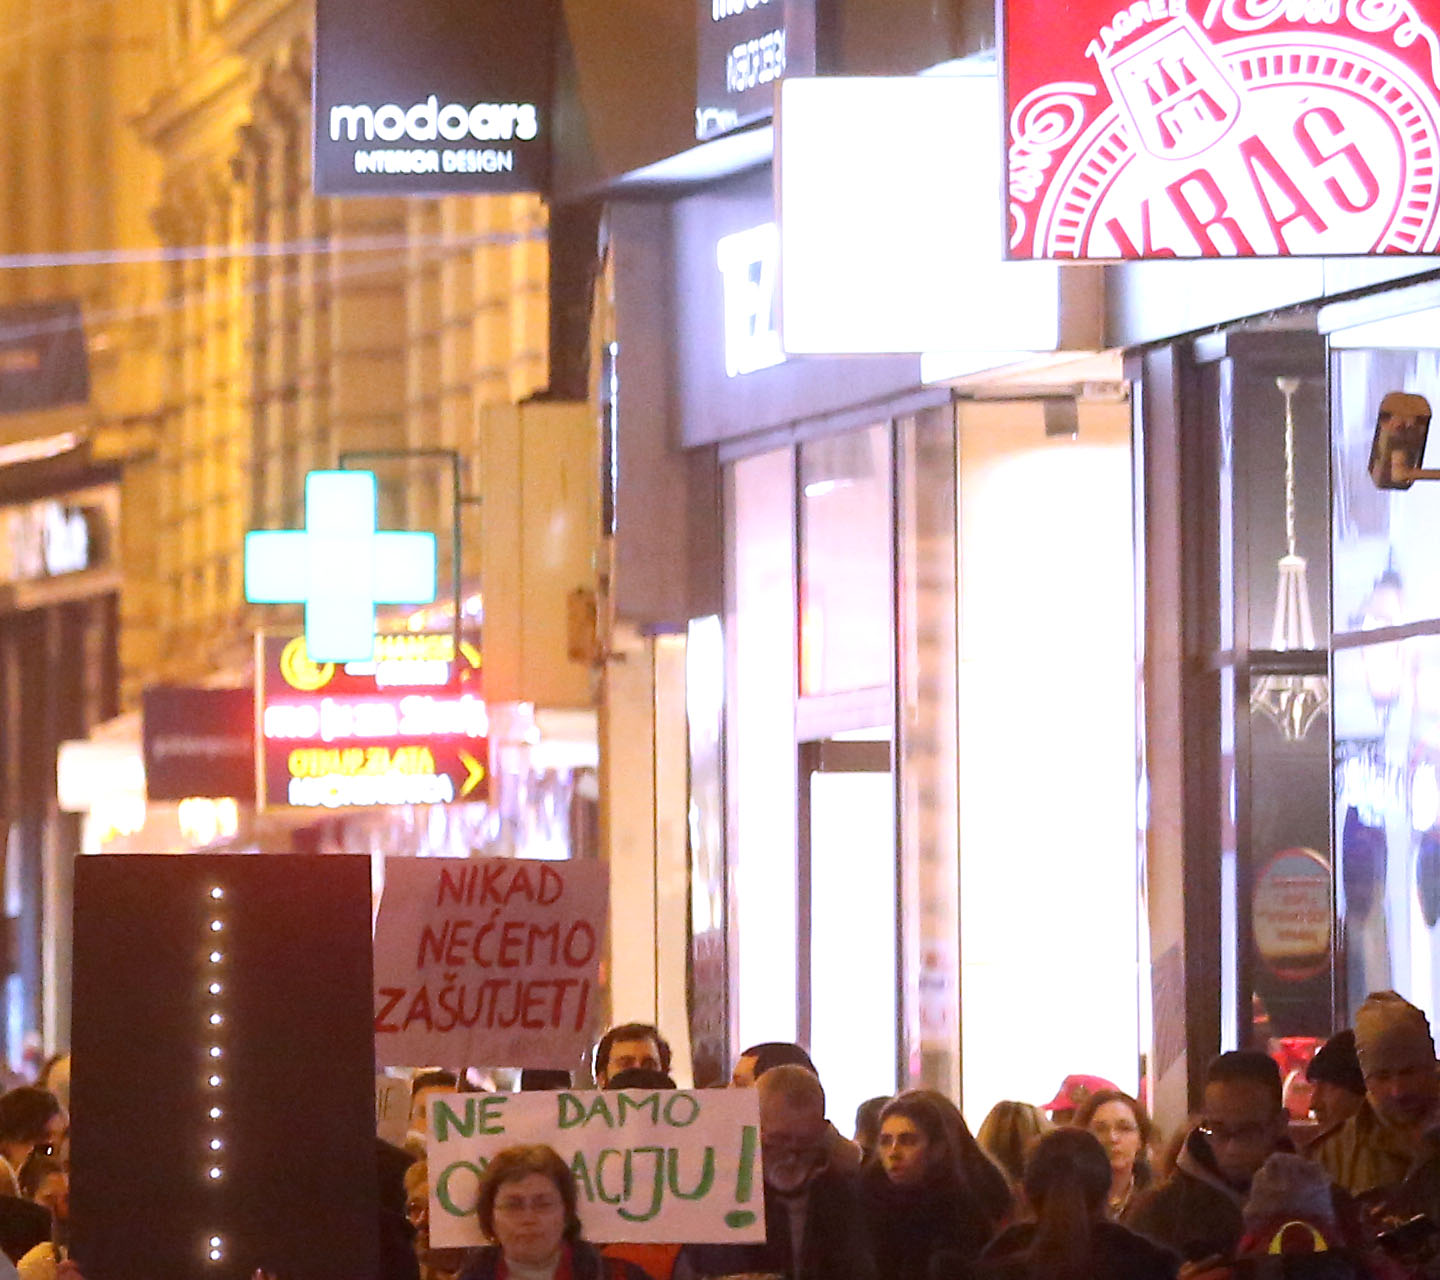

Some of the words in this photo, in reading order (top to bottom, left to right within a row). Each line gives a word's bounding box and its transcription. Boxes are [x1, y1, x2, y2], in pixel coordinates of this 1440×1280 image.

[329, 95, 537, 141] modoars
[442, 150, 513, 174] DESIGN
[436, 863, 566, 907] NIKAD
[416, 910, 596, 970] NEĆEMO
[374, 973, 590, 1034] ZAŠUTJETI
[432, 1096, 507, 1144] NE
[557, 1092, 700, 1131] DAMO
